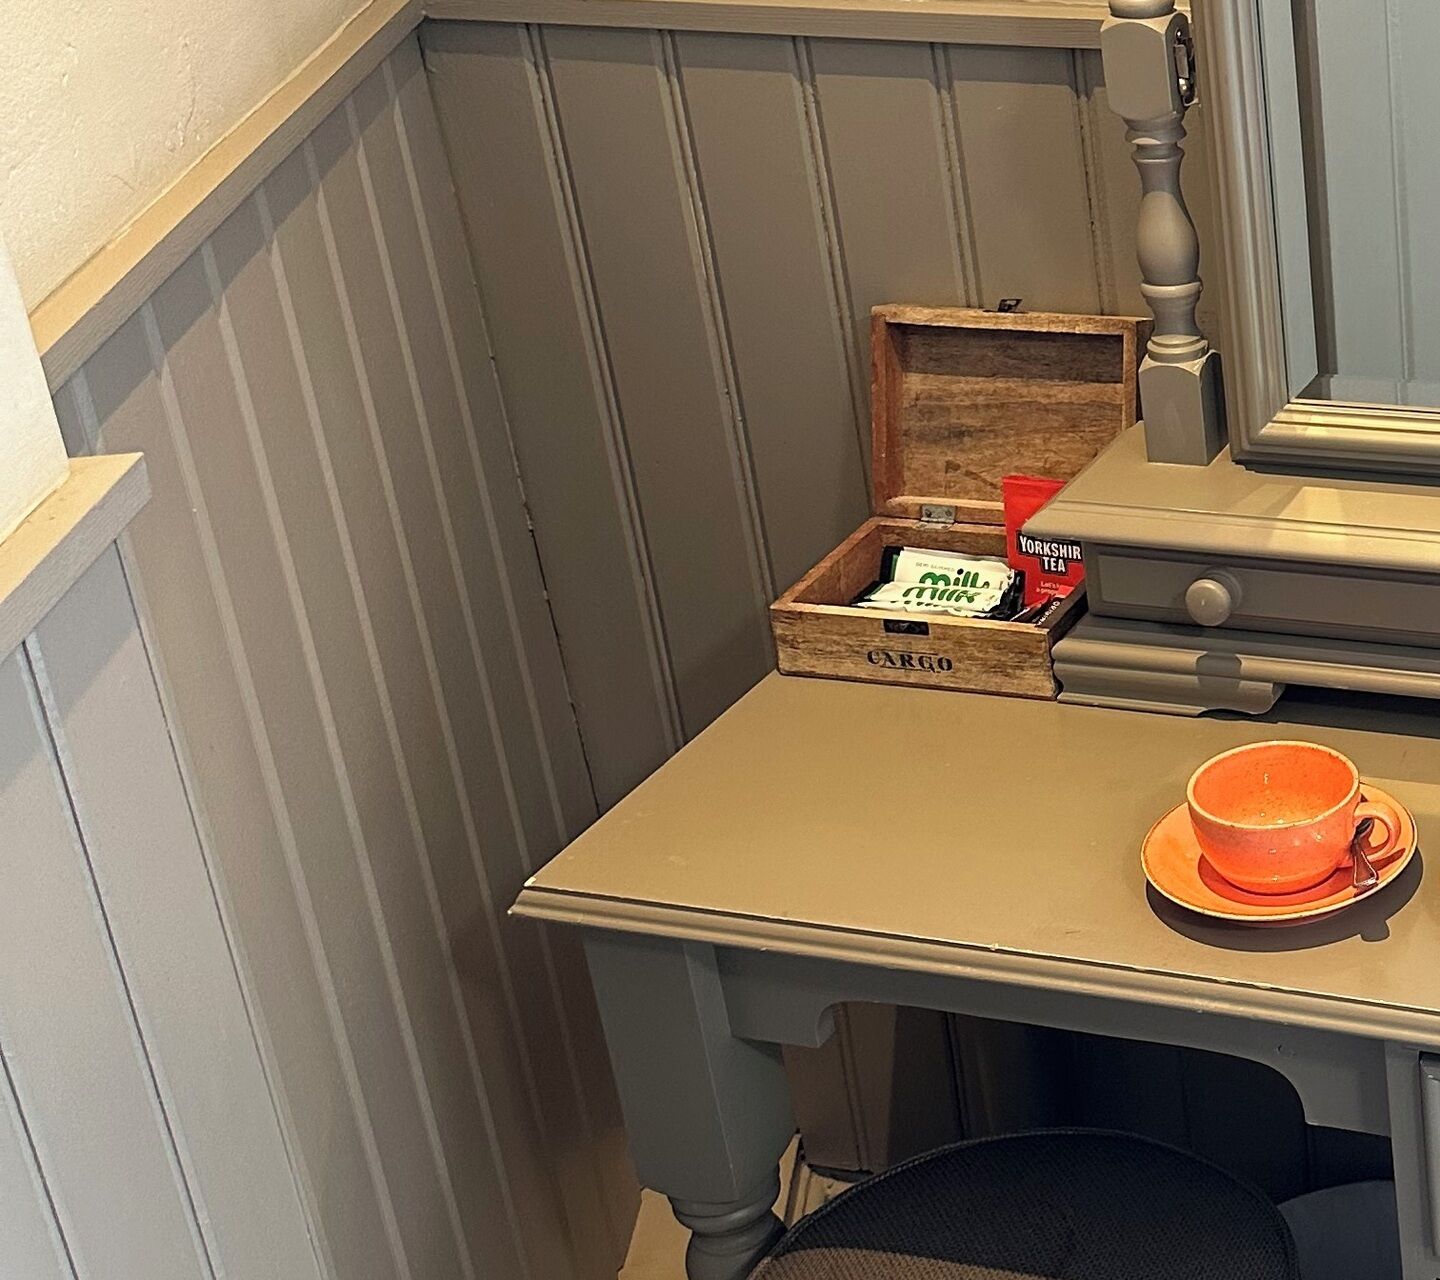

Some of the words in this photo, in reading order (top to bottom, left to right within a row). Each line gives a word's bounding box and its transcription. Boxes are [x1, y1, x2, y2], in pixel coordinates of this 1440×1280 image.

[1019, 535, 1082, 560] YORKSHIR
[1043, 556, 1066, 573] TEA
[867, 650, 953, 673] CARGO
